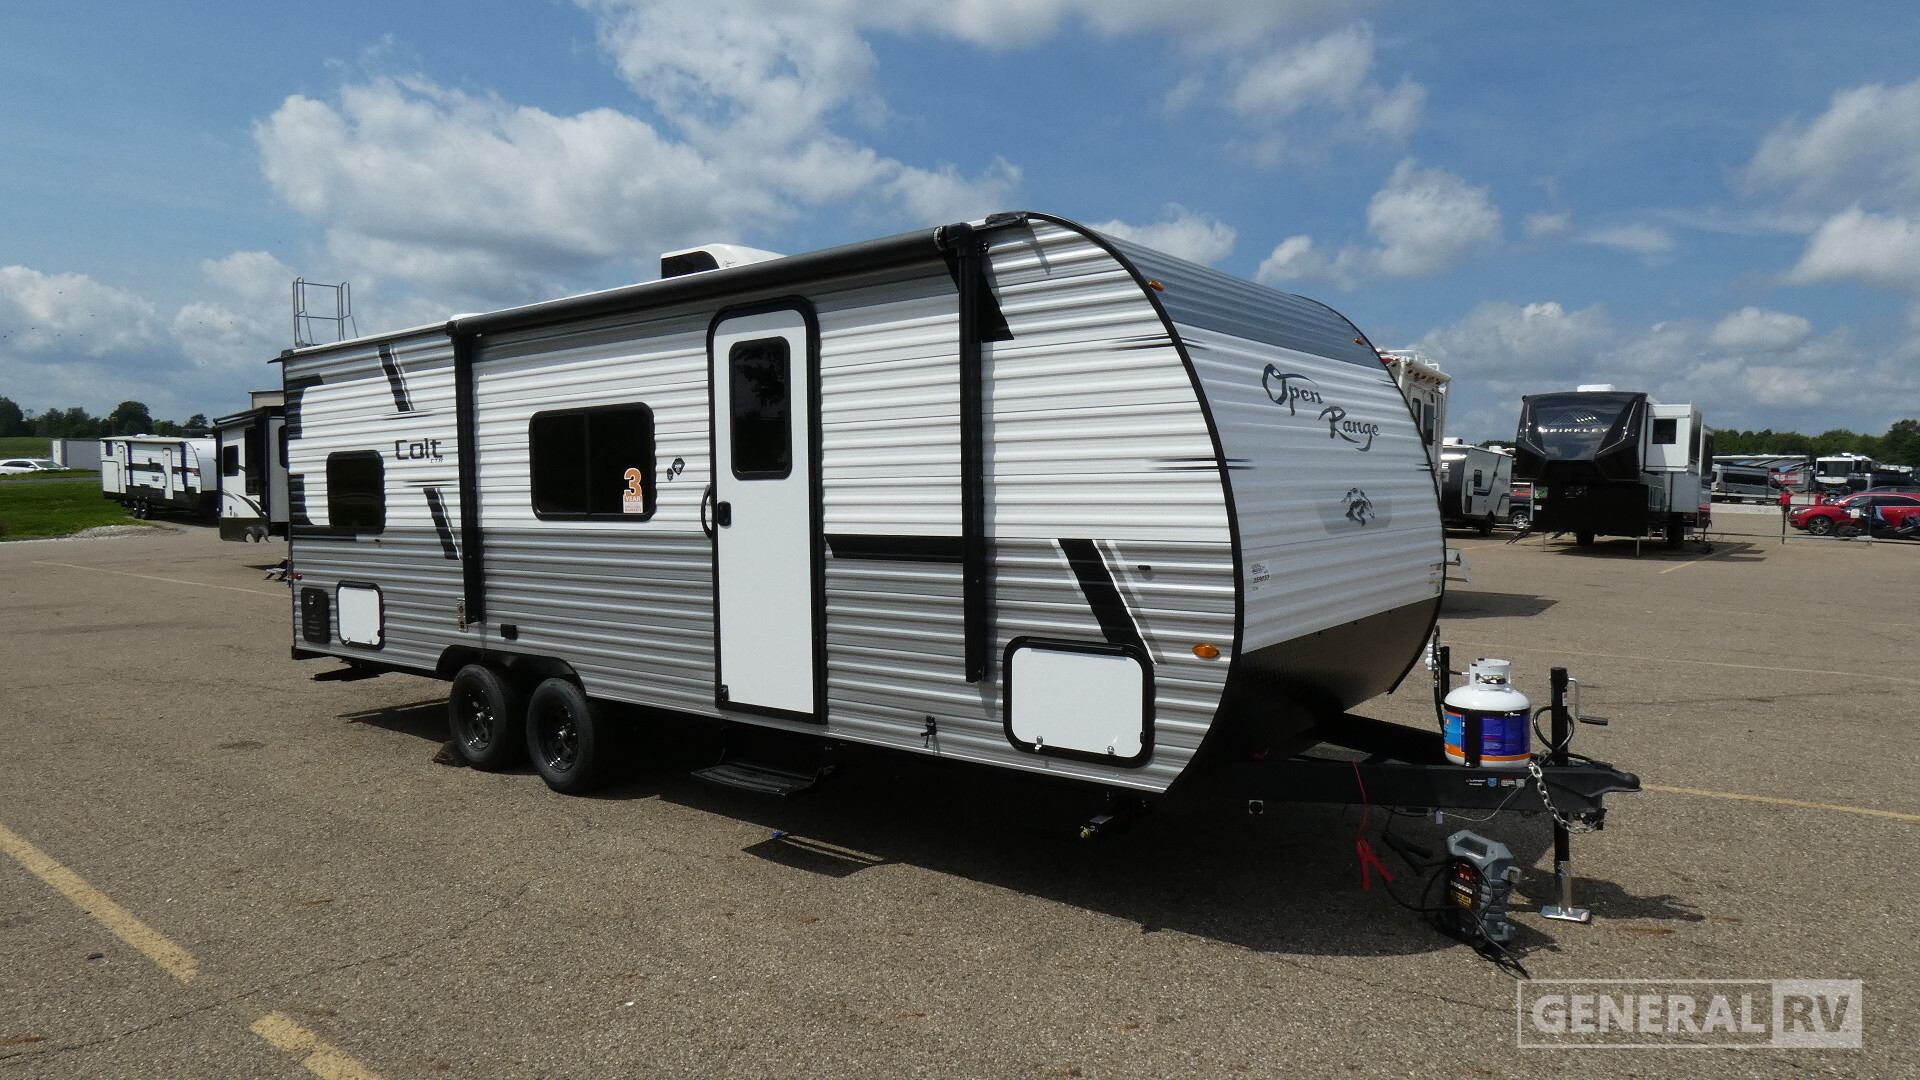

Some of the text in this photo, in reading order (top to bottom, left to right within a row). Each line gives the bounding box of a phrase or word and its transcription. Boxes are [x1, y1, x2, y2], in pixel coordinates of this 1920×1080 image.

[1262, 363, 1324, 417] Open
[1318, 405, 1380, 452] Range
[395, 437, 443, 460] Colt
[623, 467, 643, 497] 3
